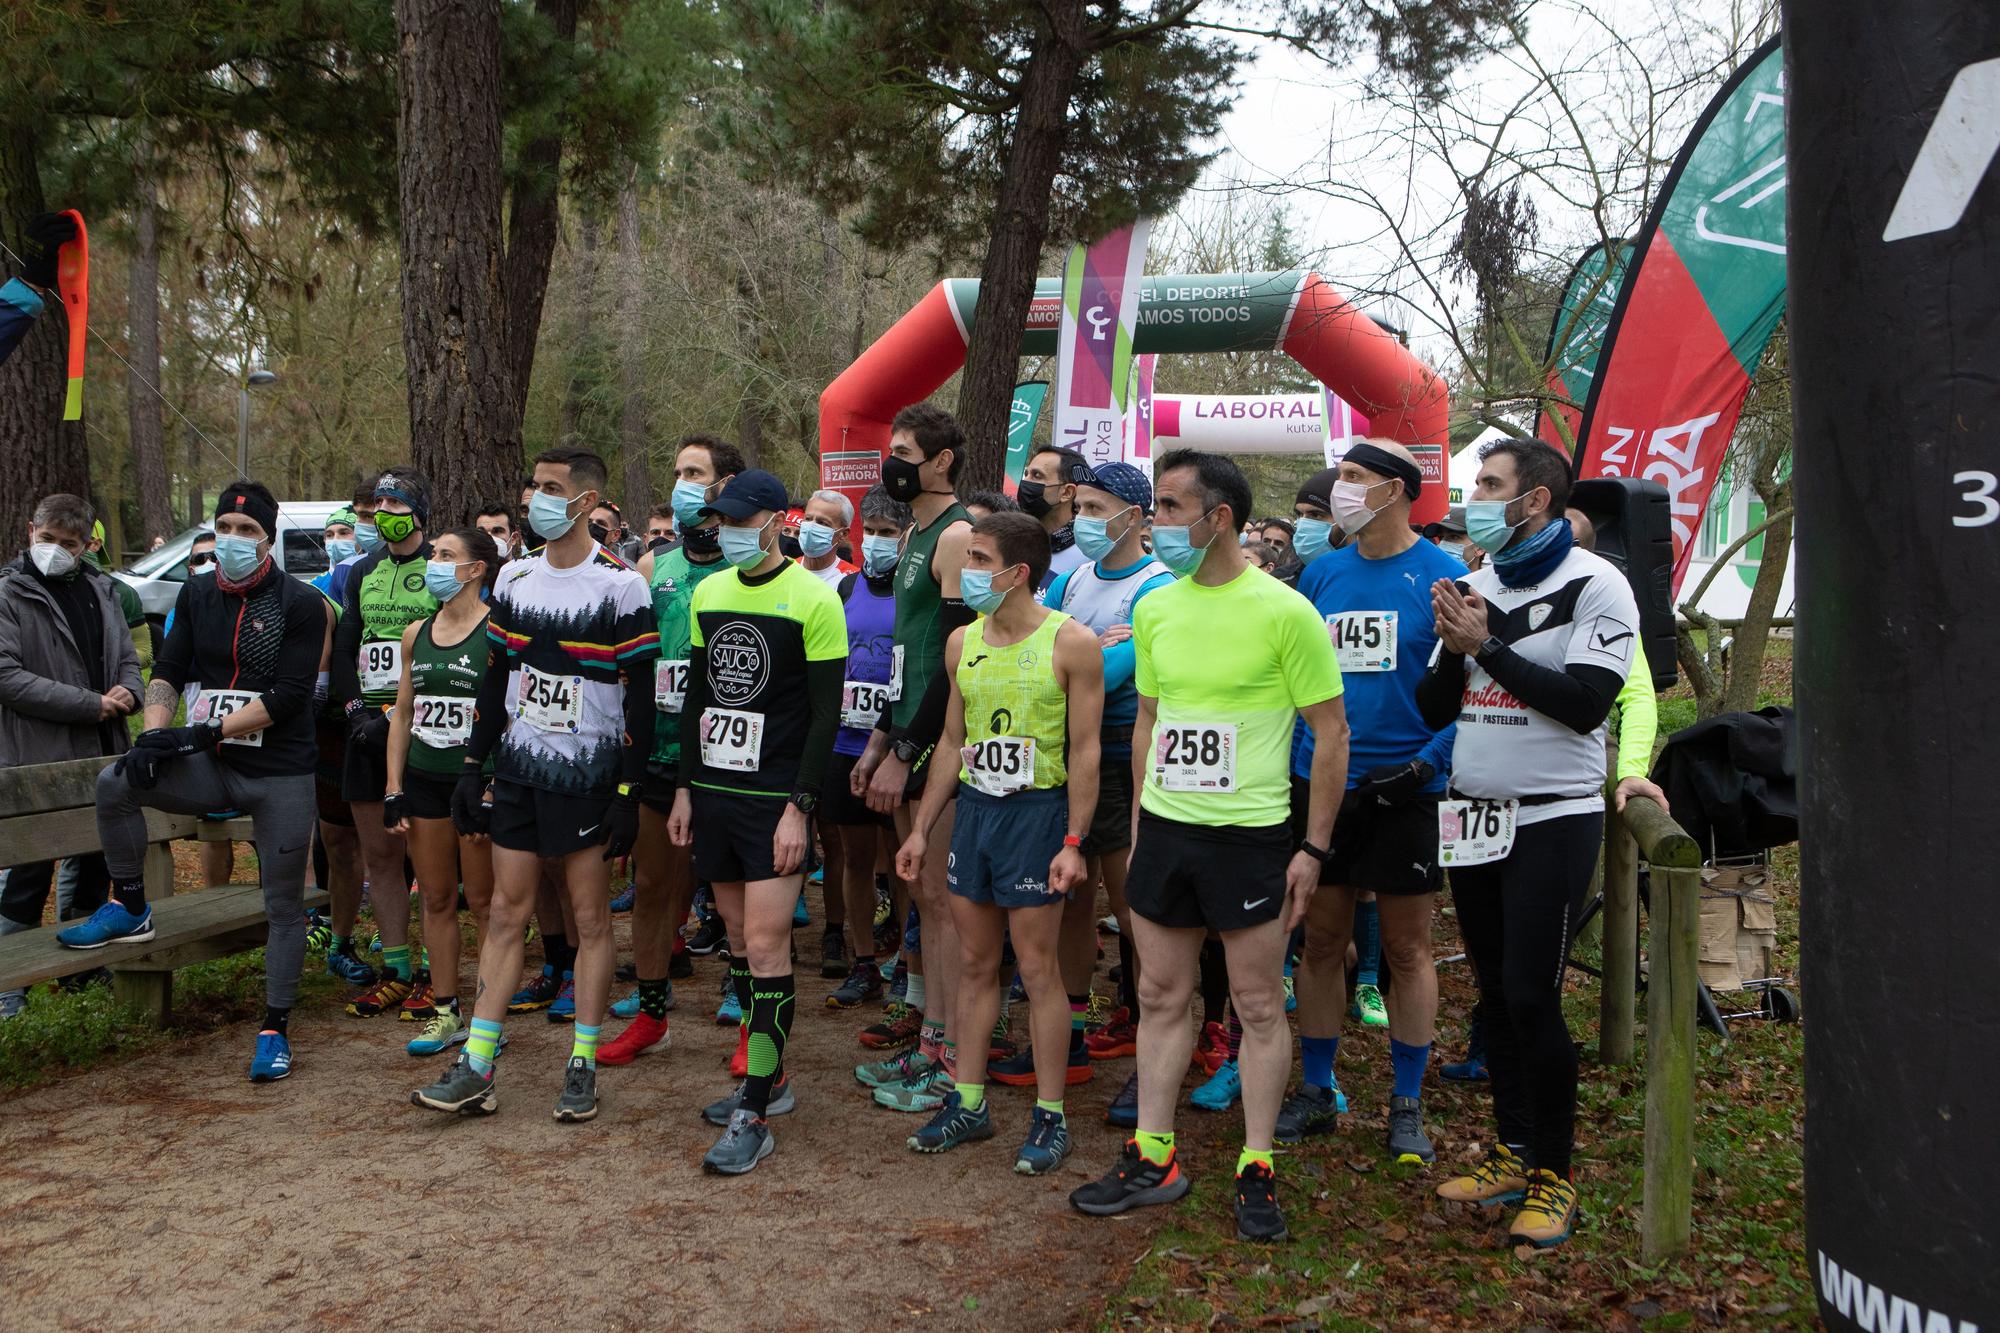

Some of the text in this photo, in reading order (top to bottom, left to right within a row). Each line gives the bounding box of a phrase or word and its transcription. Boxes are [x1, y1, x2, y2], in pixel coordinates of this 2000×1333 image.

[1140, 288, 1162, 302] EL
[1167, 285, 1250, 301] DEPORTE
[1030, 303, 1060, 311] UTACIÓN
[1136, 306, 1251, 325] AMOS TODOS
[1195, 400, 1321, 419] LABORAL
[1286, 423, 1321, 434] kutxa
[832, 470, 879, 481] ZAMORA
[362, 603, 425, 615] CORRECAMINOS
[1336, 616, 1381, 649] 145
[369, 645, 394, 672] 99
[713, 648, 760, 671] SAUCO
[447, 663, 479, 677] Cifuentes
[667, 664, 691, 693] 12
[450, 679, 472, 689] canal
[526, 673, 571, 711] 254
[851, 686, 888, 713] 136
[420, 700, 463, 730] 225
[1482, 713, 1529, 726] PASTELERIA
[707, 713, 748, 748] 279
[1164, 728, 1220, 766] 258
[972, 741, 1021, 775] 203
[1457, 805, 1502, 841] 176
[730, 967, 752, 976] pso
